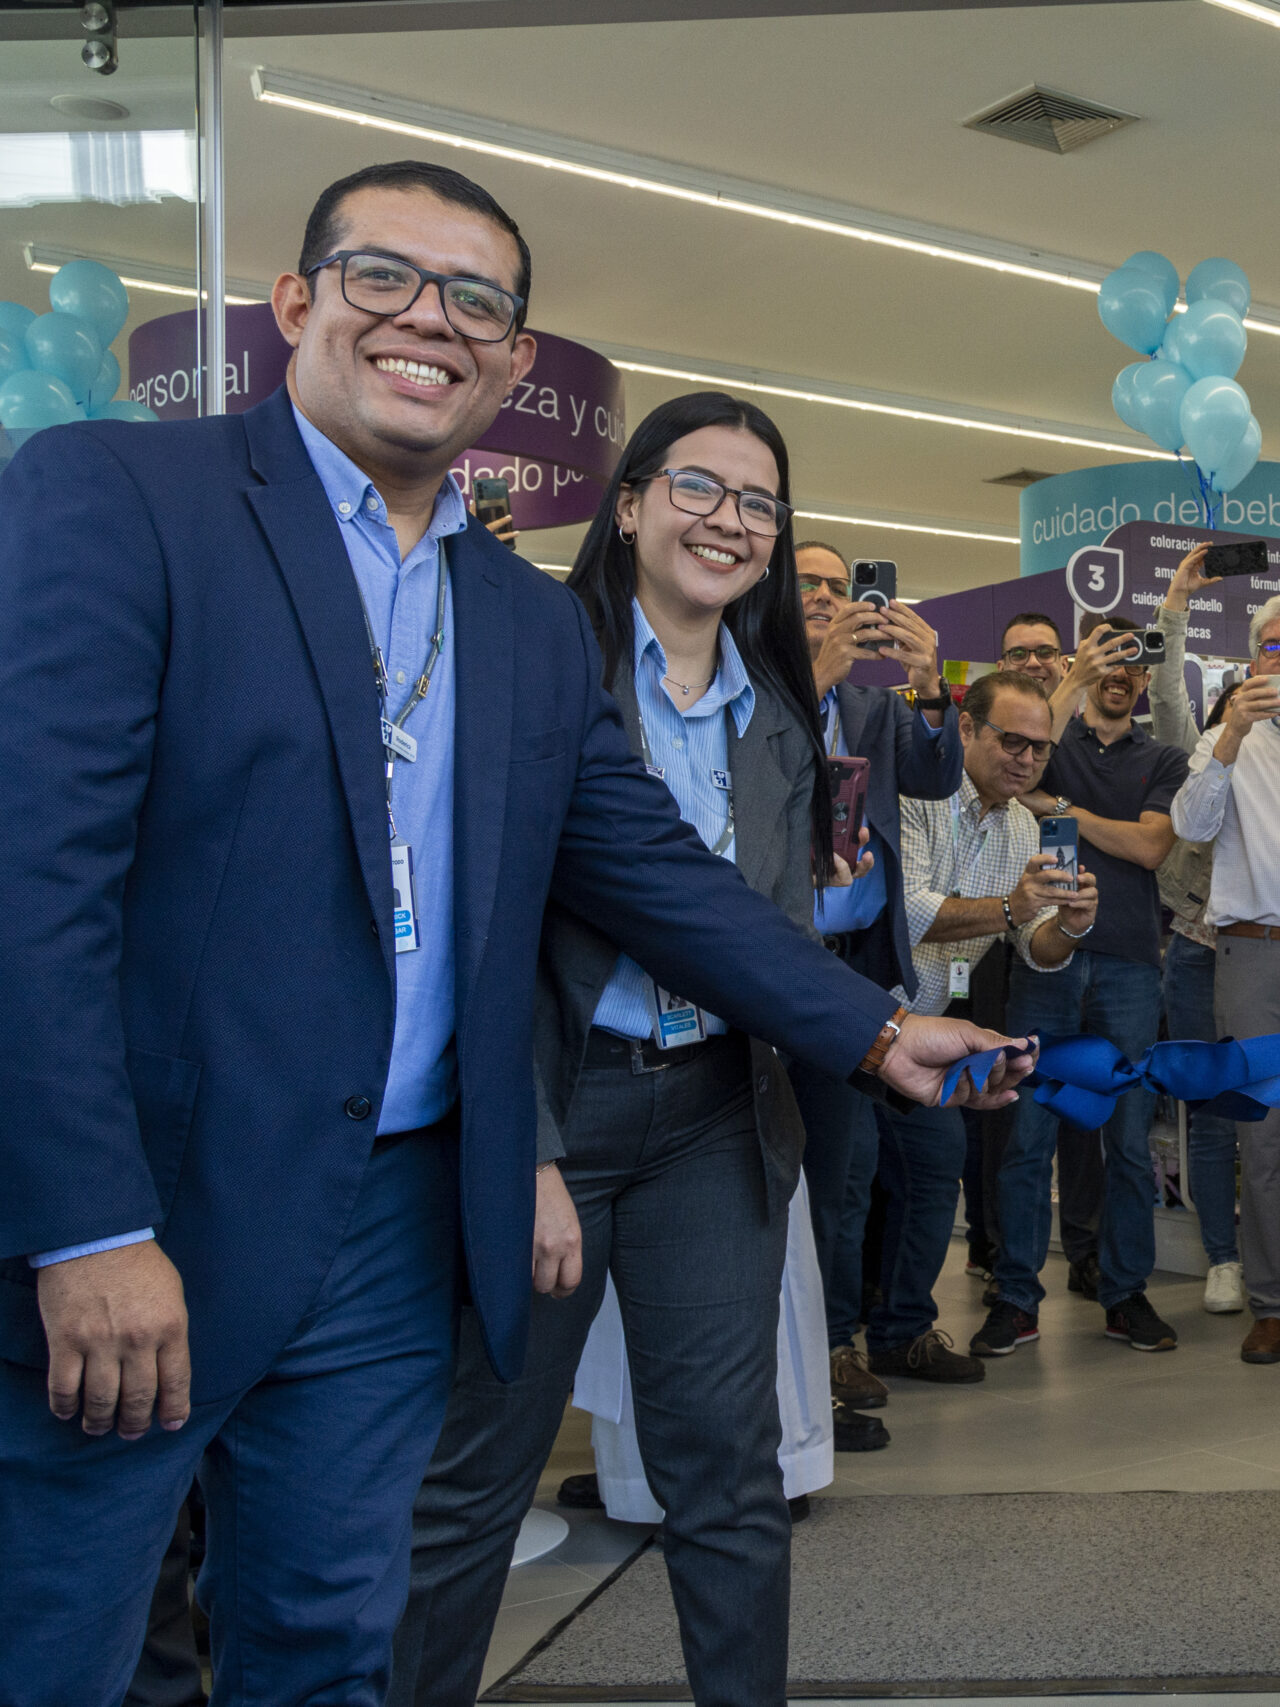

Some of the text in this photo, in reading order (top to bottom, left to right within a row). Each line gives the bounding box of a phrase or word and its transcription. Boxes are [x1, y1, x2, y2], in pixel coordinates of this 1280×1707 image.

[569, 394, 587, 437] y
[1032, 496, 1141, 545] cuidado
[1153, 492, 1208, 526] del
[1087, 564, 1106, 592] 3
[1188, 598, 1223, 613] cabello
